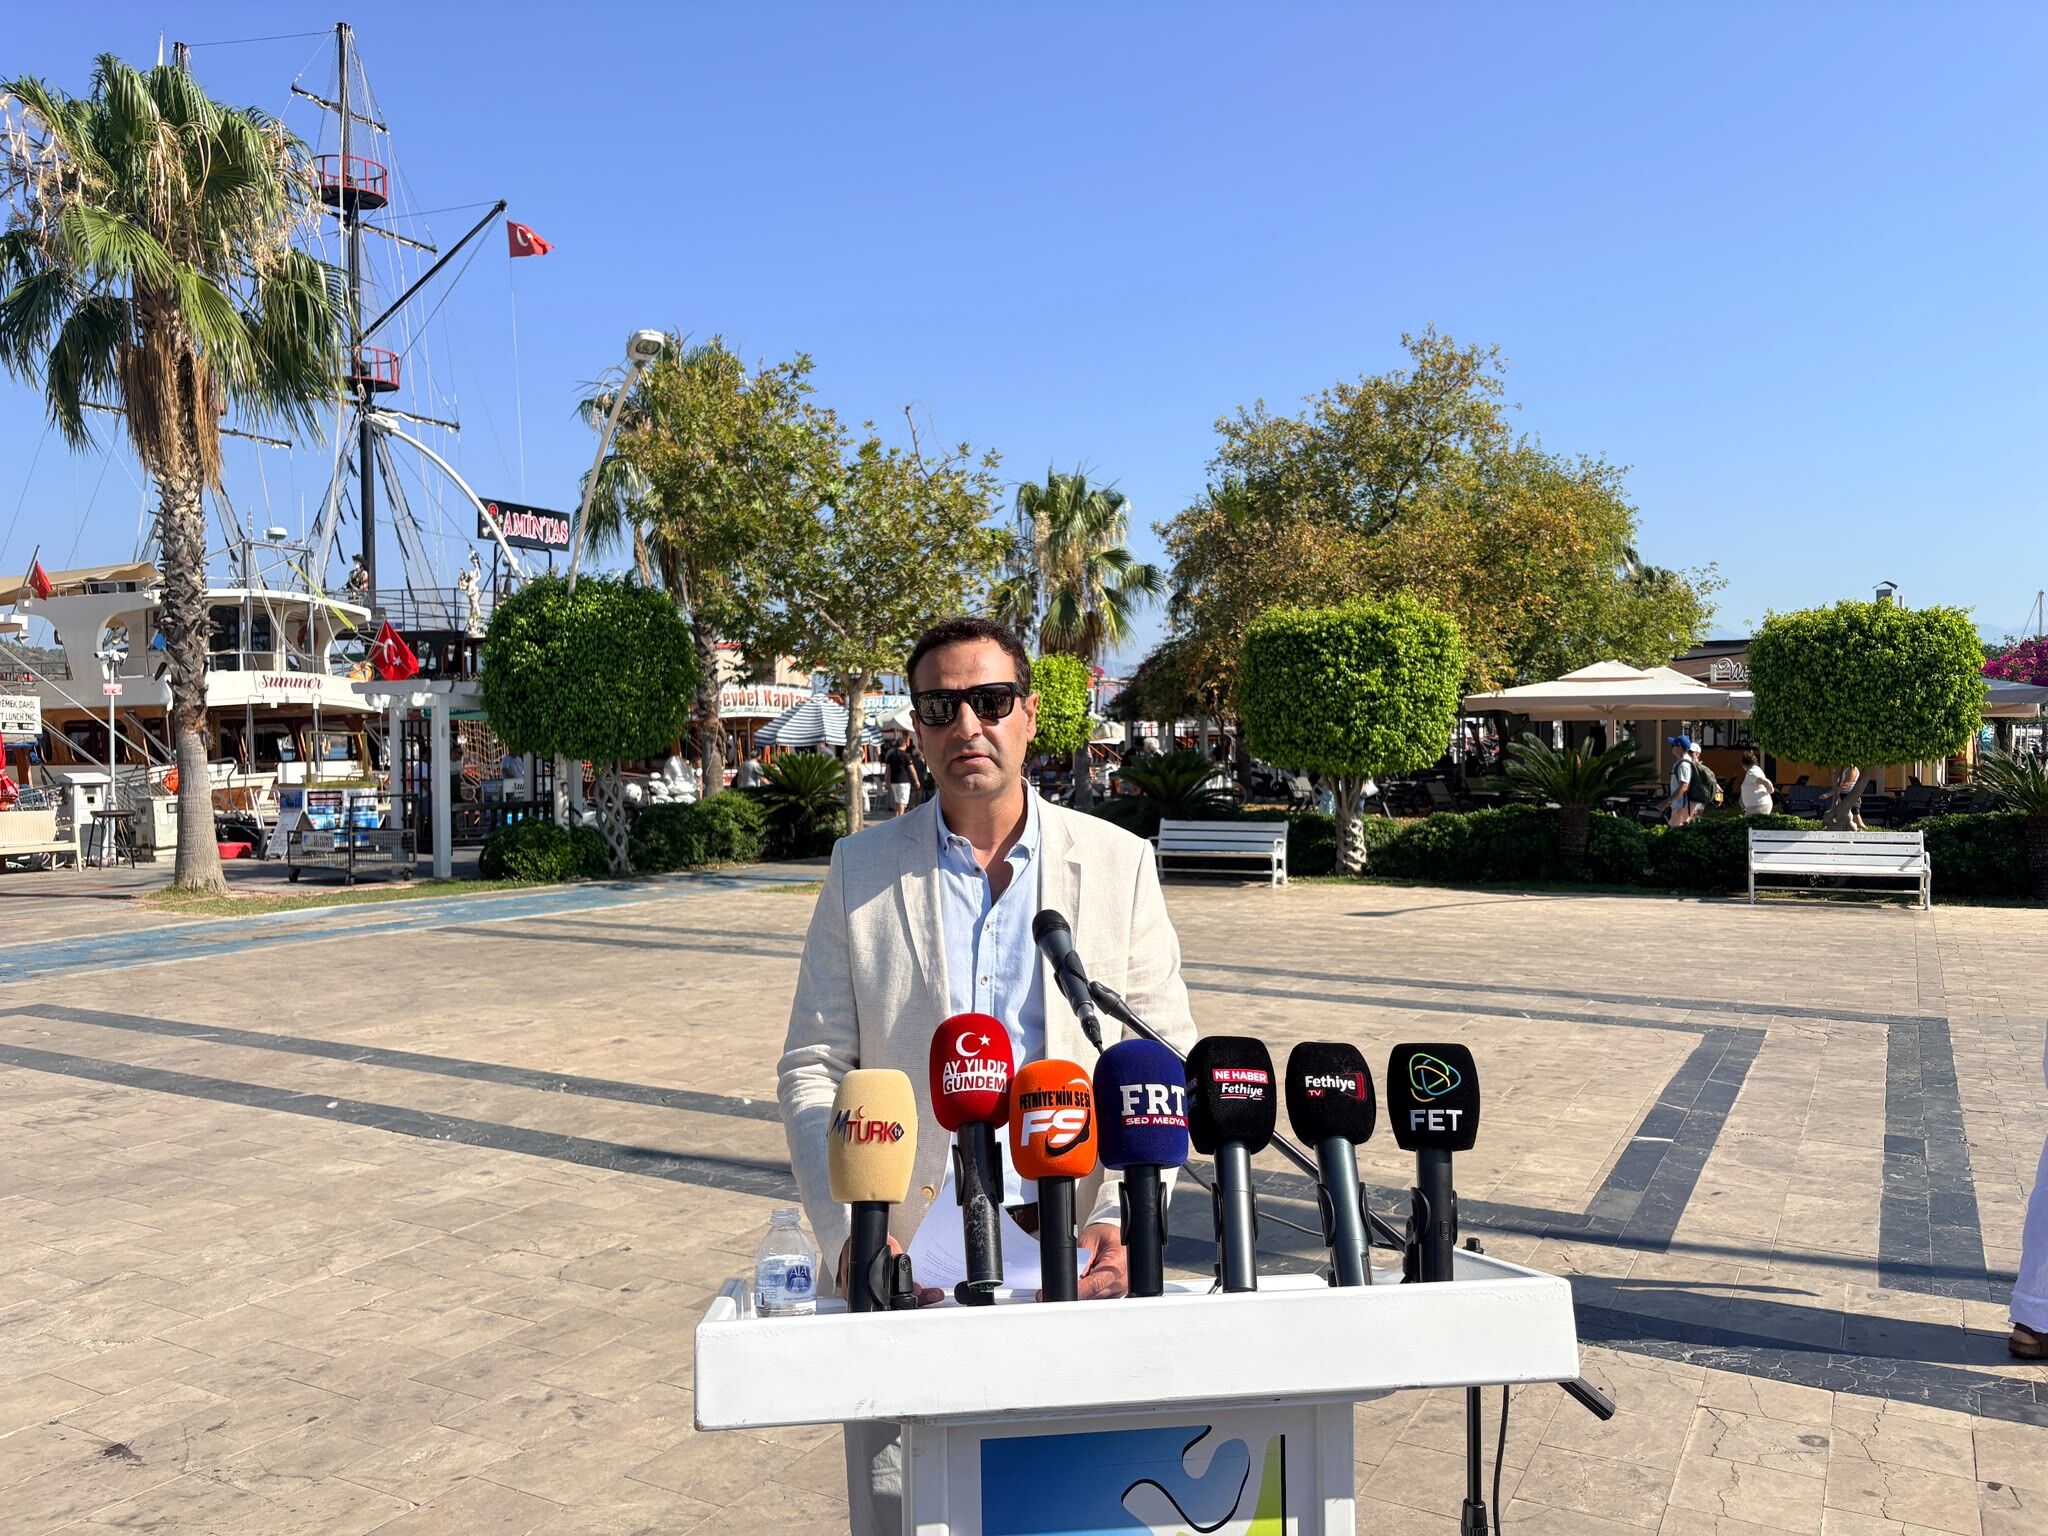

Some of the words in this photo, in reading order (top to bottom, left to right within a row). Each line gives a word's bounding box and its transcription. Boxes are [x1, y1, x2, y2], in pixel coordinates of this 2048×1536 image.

[720, 688, 759, 707] evdet
[944, 1060, 960, 1076] AY
[965, 1059, 1008, 1074] YILDIZ
[944, 1074, 1006, 1093] GÜNDEM
[1215, 1070, 1230, 1080] NE
[1232, 1071, 1267, 1083] HABER
[1304, 1075, 1356, 1092] Fethiye
[1221, 1082, 1263, 1098] Fethiye
[1308, 1089, 1322, 1097] TV
[1120, 1084, 1185, 1116] FRT
[1126, 1117, 1149, 1125] SED
[1152, 1117, 1186, 1127] MEDYA
[1410, 1109, 1463, 1131] FET
